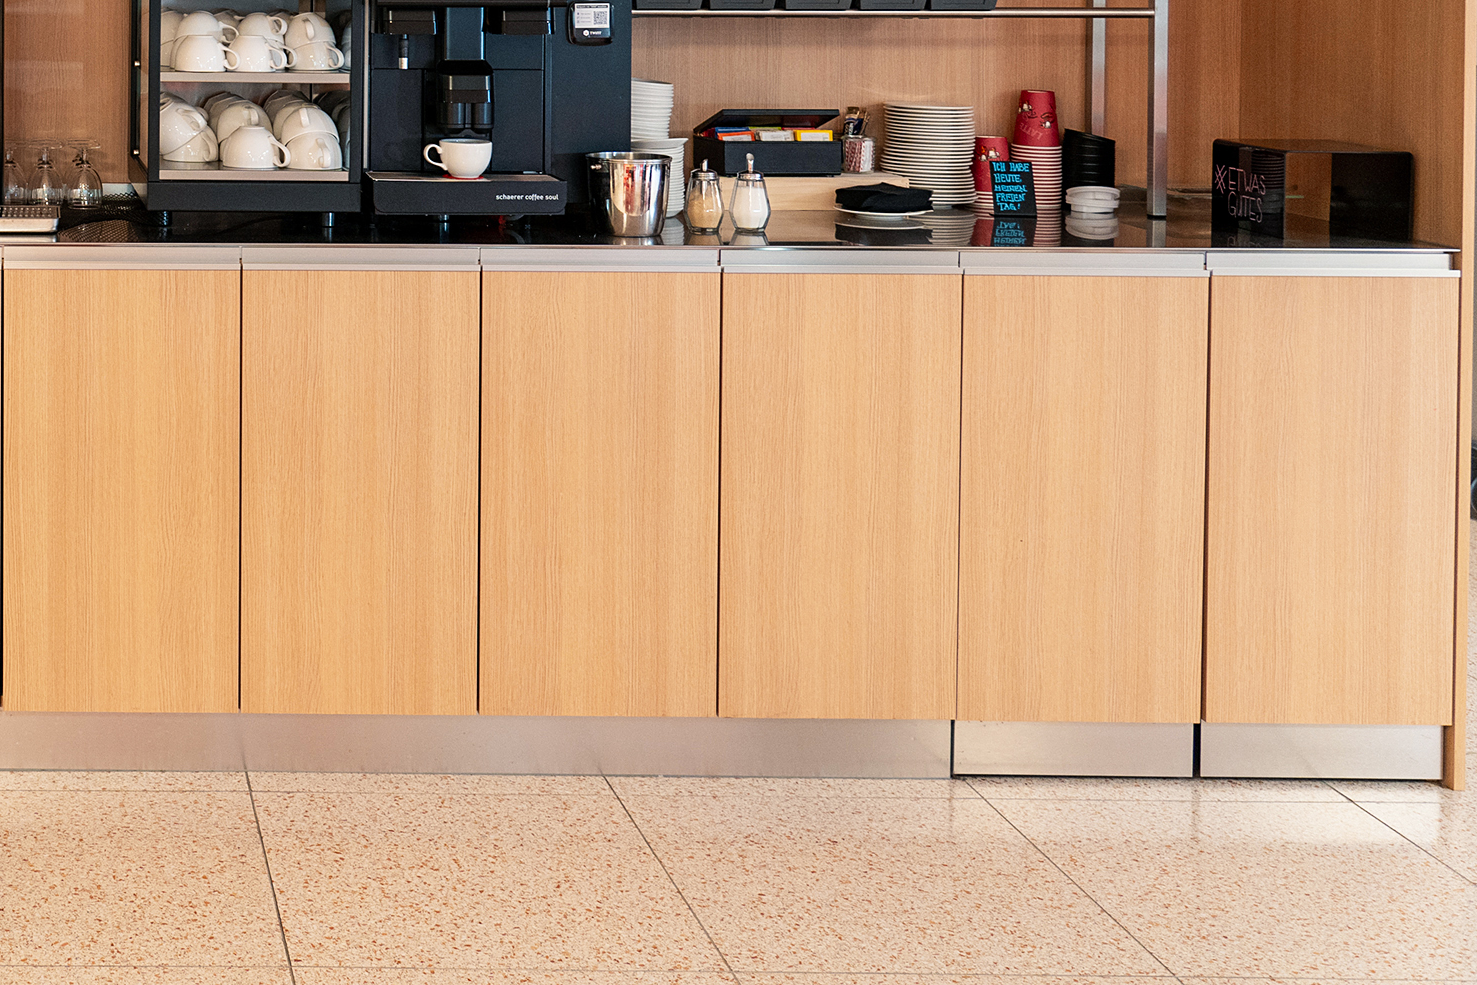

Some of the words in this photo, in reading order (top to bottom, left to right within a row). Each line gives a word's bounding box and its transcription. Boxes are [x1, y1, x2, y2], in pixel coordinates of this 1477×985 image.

[1009, 162, 1030, 173] HABE
[495, 193, 523, 201] schaerer
[524, 193, 544, 202] coffee
[545, 193, 559, 201] soul
